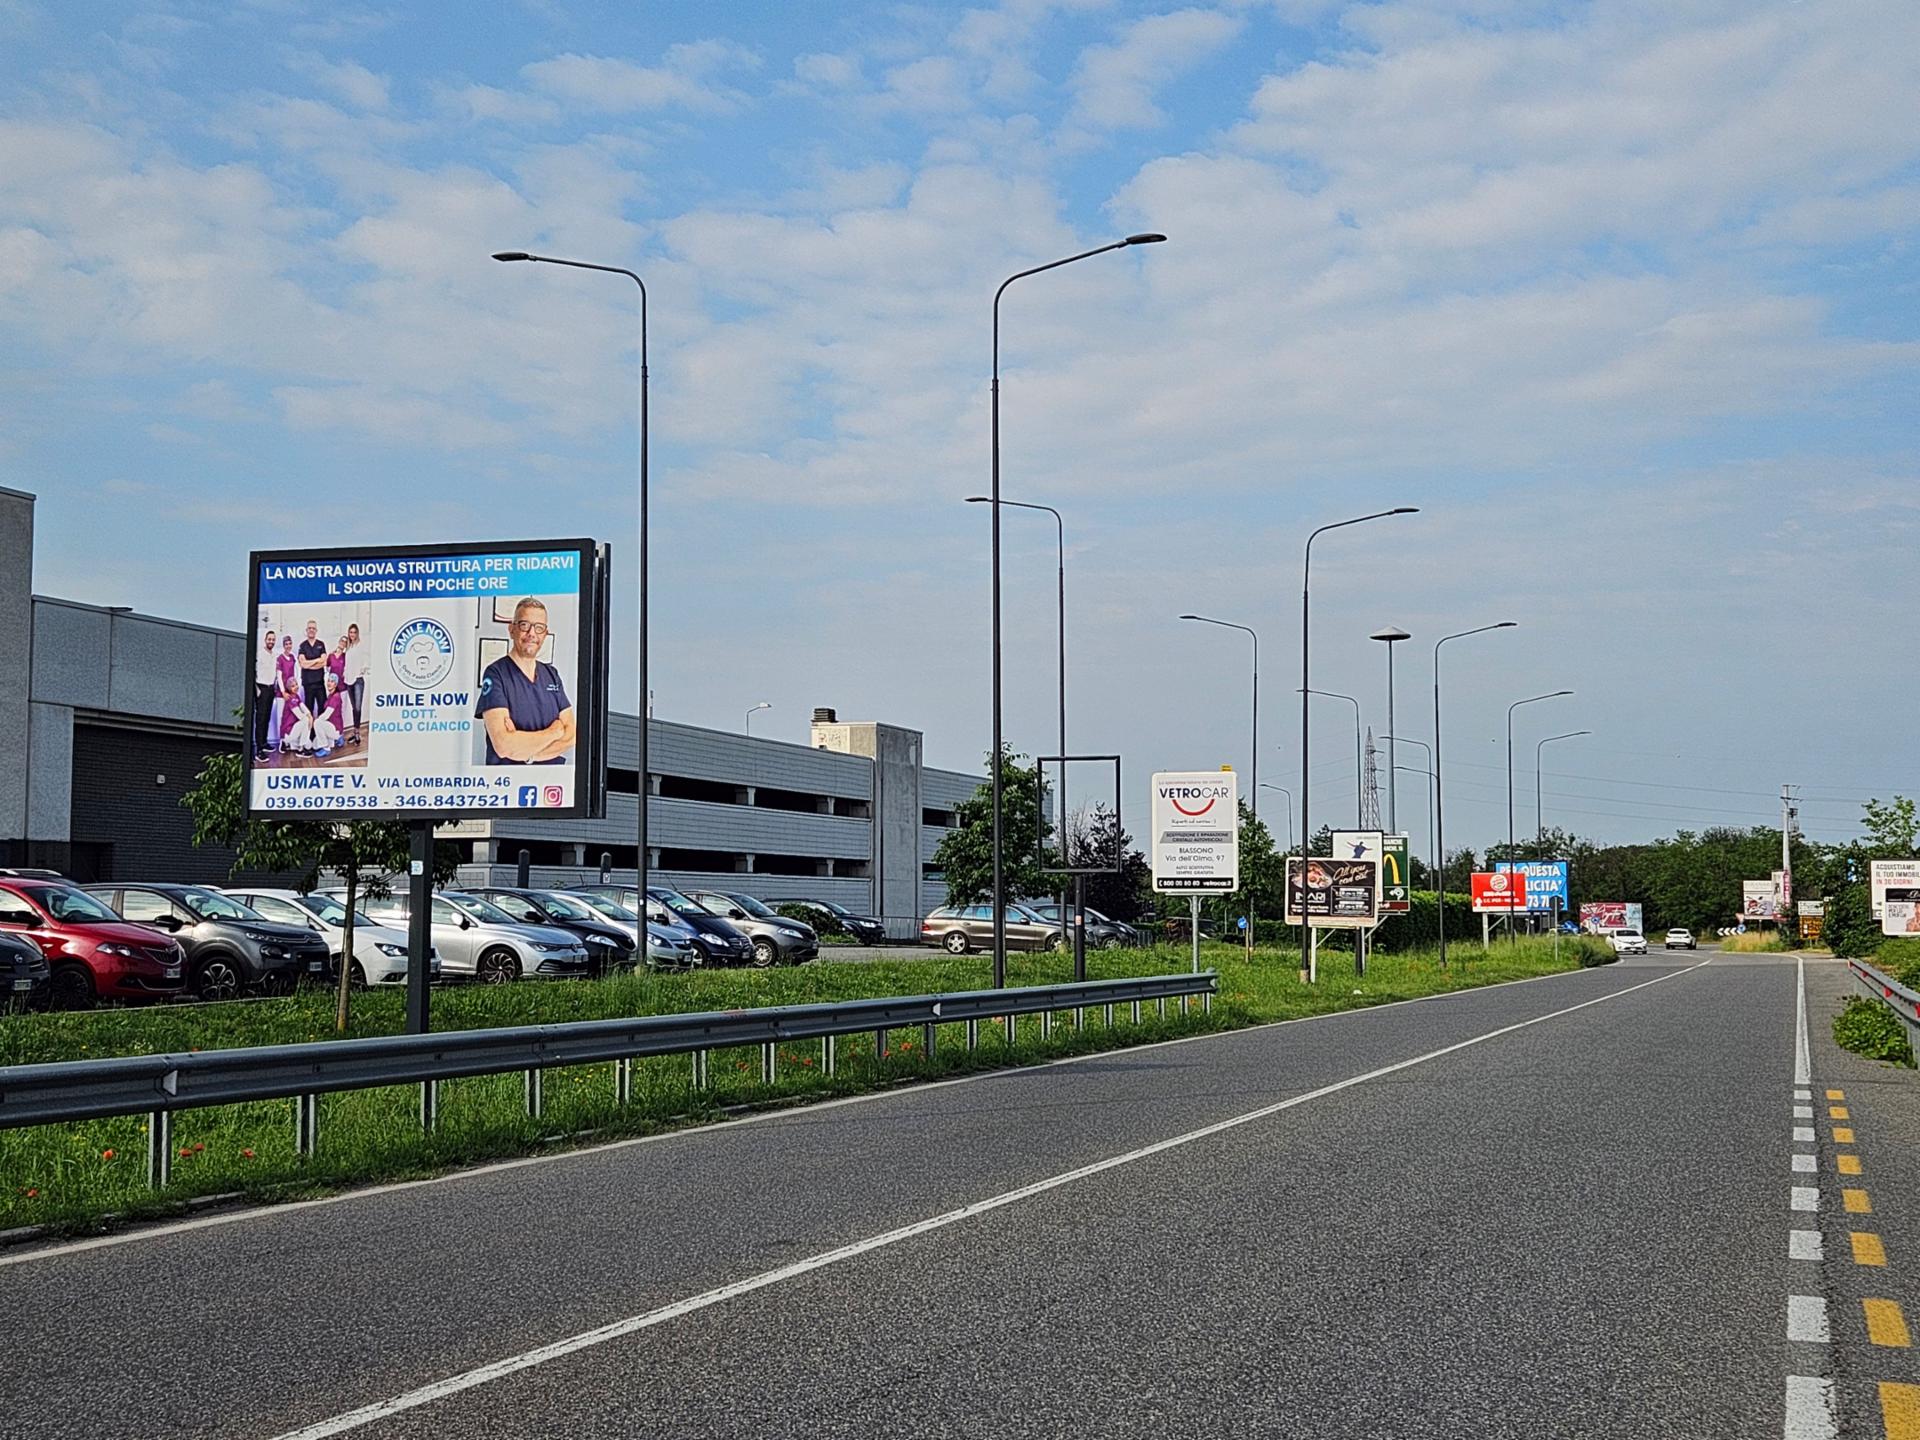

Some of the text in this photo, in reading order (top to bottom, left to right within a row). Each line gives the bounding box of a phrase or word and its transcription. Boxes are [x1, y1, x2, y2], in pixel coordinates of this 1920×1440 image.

[265, 556, 574, 579] LA NOSTRA NUOVA STRUTTURA PER RIDARVI
[328, 577, 508, 595] IL SORRISO IN POCHE ORE
[396, 623, 450, 653] SMILE NOW
[376, 692, 469, 707] SMILE NOW
[402, 709, 437, 719] DOTT.
[371, 721, 470, 732] PAOLO CIANCIO
[267, 774, 510, 789] USMATE V. VIA LOMBARDIA, 46
[1160, 787, 1229, 799] VETROCAR
[265, 796, 378, 808] 039.6079538
[395, 795, 509, 807] 346.8437521
[1522, 865, 1561, 876] QUESTA
[1526, 880, 1562, 891] LICITA'
